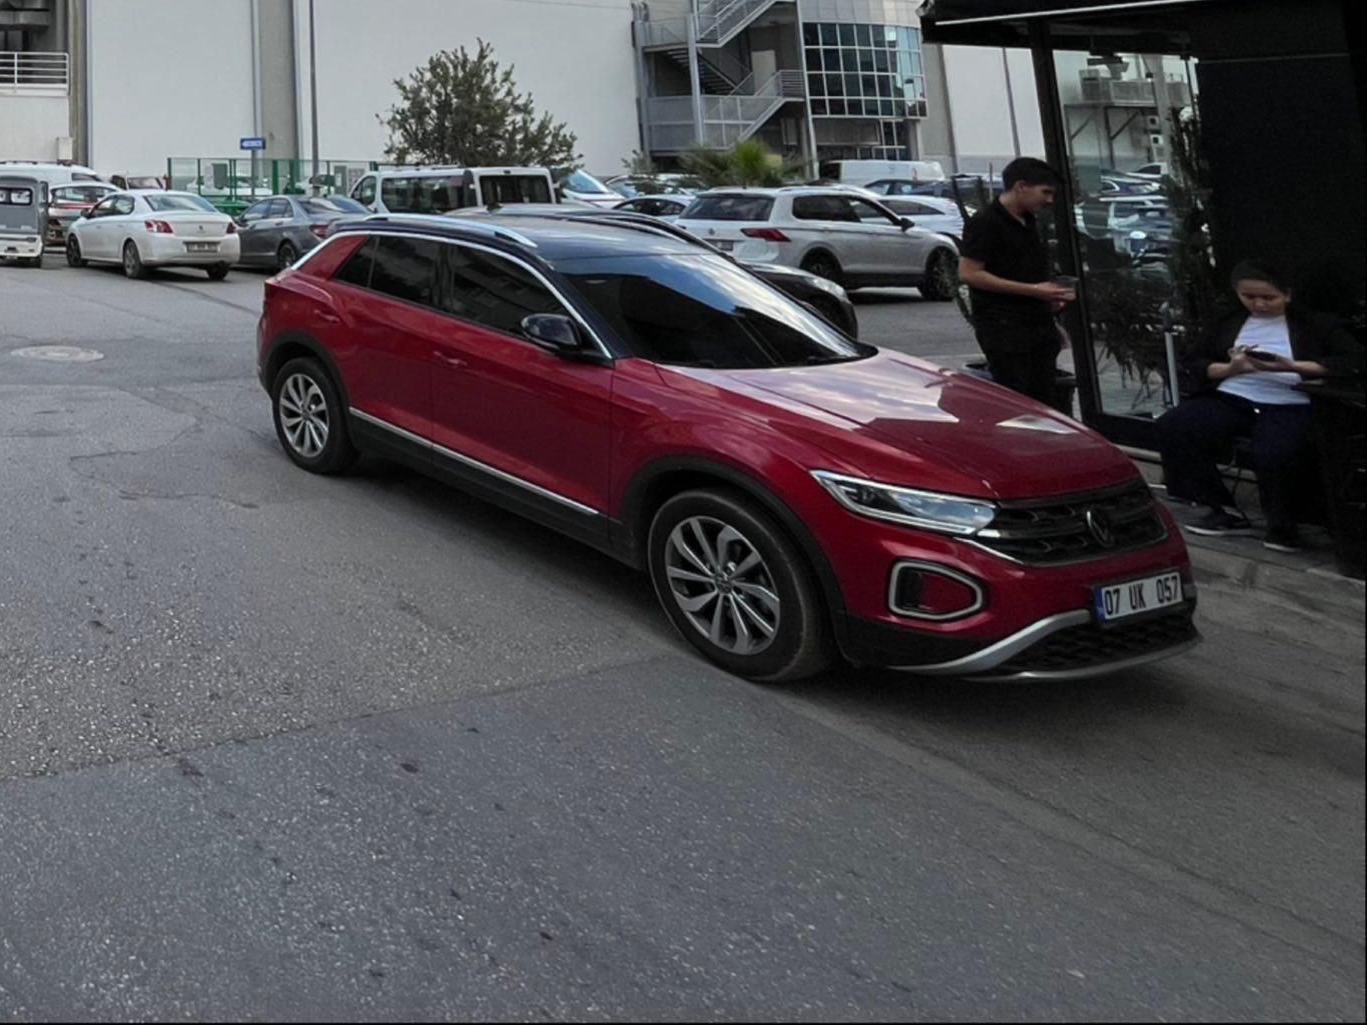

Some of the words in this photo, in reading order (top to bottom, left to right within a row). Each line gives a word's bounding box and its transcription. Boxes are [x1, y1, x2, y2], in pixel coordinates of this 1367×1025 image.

[1104, 589, 1120, 615] 07
[1129, 583, 1146, 610] UK
[1156, 577, 1179, 604] 057
